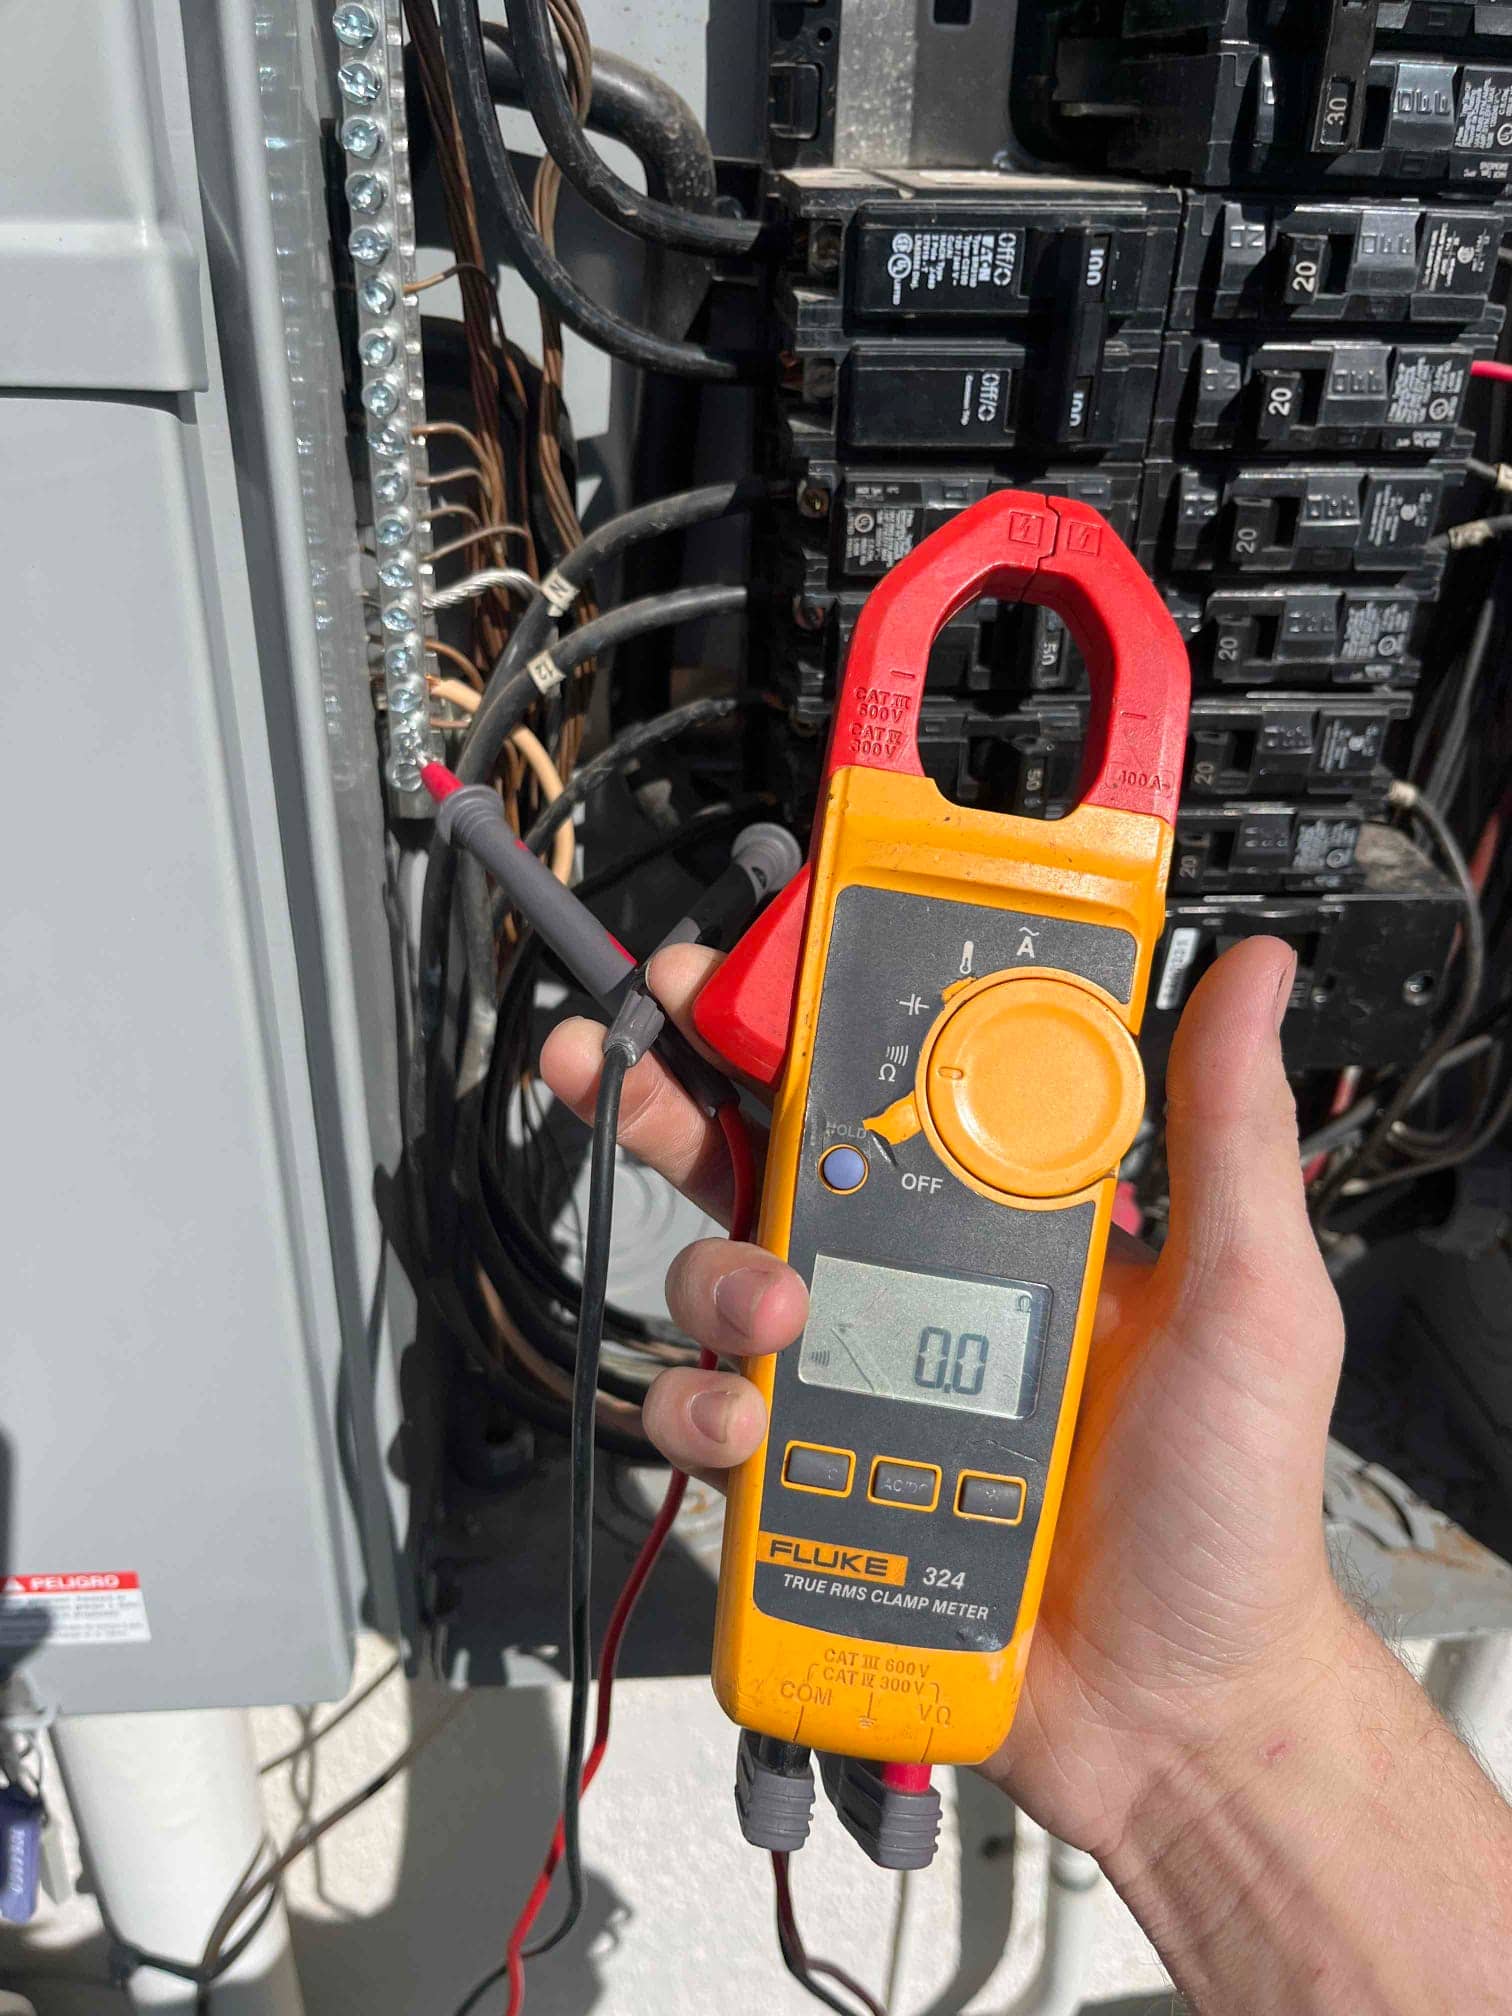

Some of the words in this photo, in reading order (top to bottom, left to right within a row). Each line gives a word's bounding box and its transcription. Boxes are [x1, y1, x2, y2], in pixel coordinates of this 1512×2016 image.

[1326, 97, 1348, 126] 30
[1292, 261, 1317, 293] 20
[1268, 387, 1293, 416] 20
[1236, 528, 1257, 554] 20
[1218, 636, 1239, 661] 20
[855, 686, 890, 706] CAT
[851, 722, 886, 741] CAT
[1025, 768, 1042, 791] 50
[1194, 761, 1215, 785] 20
[1179, 855, 1198, 879] 20
[825, 1120, 867, 1139] HOLD
[901, 1172, 943, 1194] OFF
[914, 1326, 989, 1395] 0.0
[770, 1540, 889, 1577] FLUKE
[30, 1573, 120, 1591] PELIGRO
[922, 1566, 966, 1590] 324
[783, 1574, 827, 1595] TRUE
[830, 1582, 868, 1600] RMS
[871, 1589, 929, 1610] CLAMP
[933, 1600, 989, 1620] METER
[823, 1648, 858, 1667] CAT
[863, 1655, 881, 1670] III
[823, 1667, 859, 1687] CAT
[780, 1679, 833, 1706] COM
